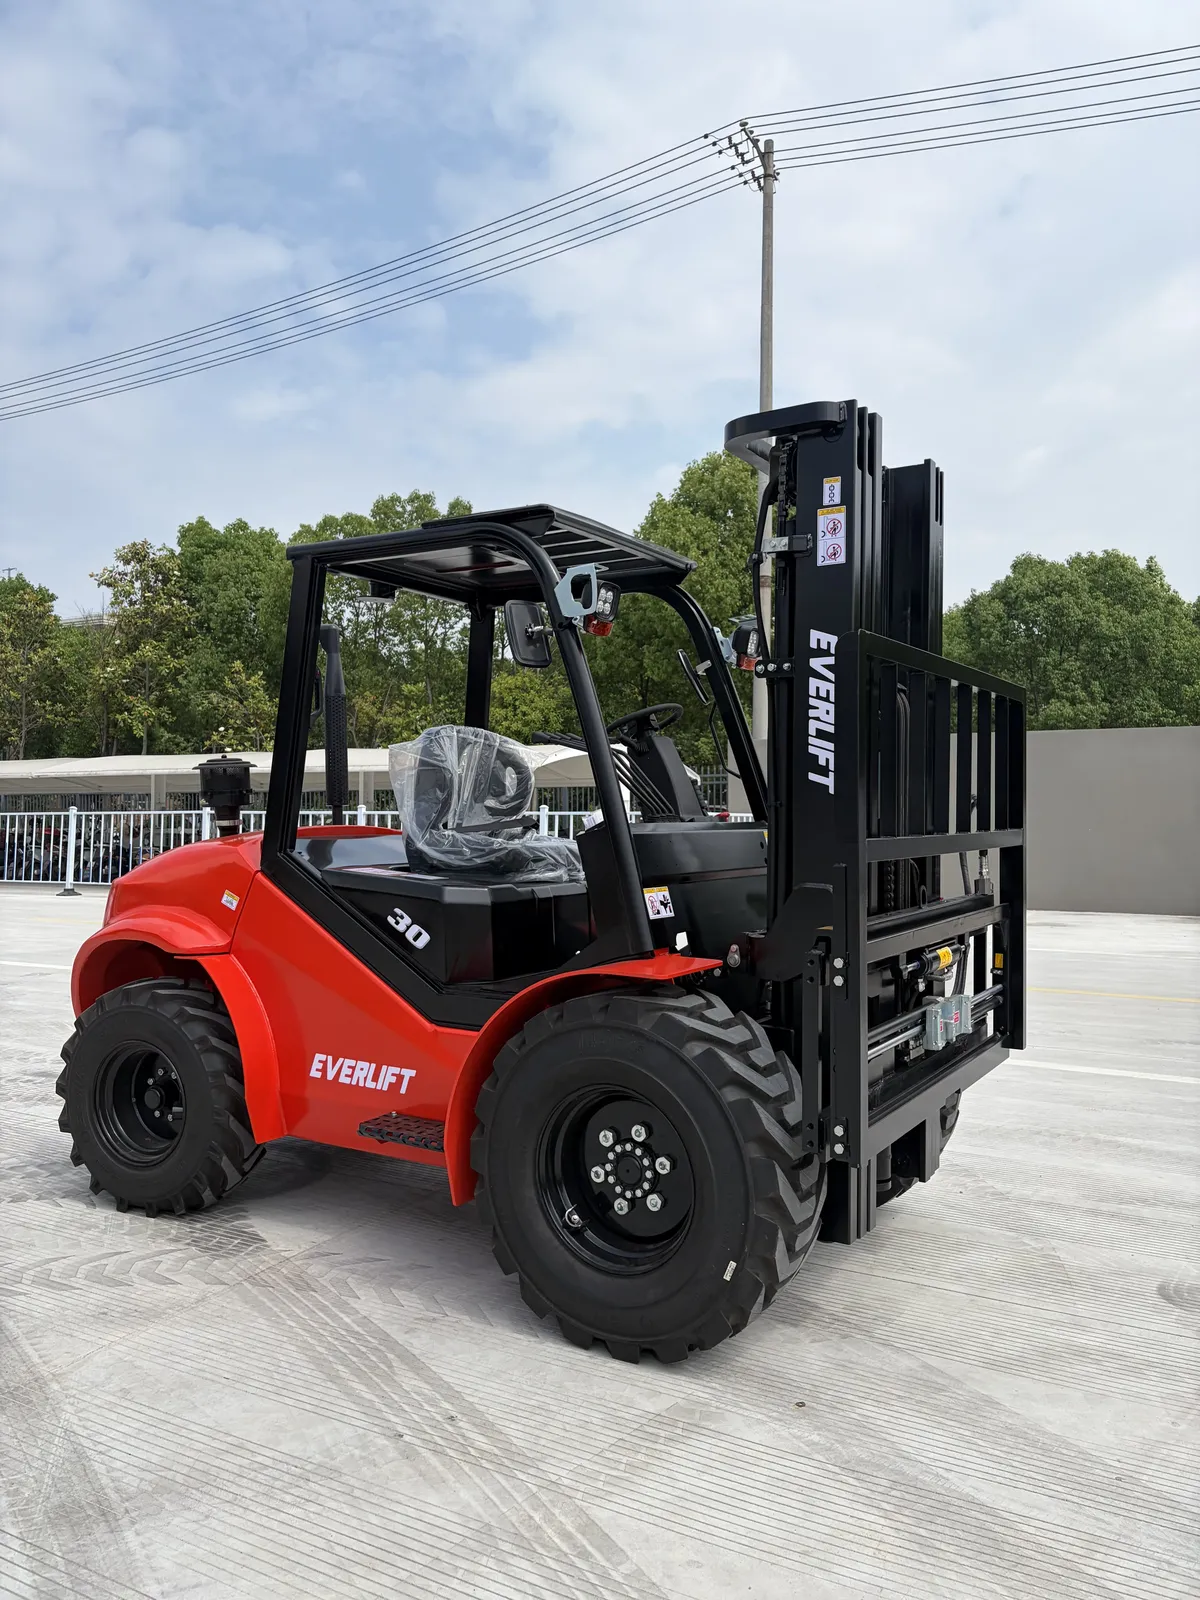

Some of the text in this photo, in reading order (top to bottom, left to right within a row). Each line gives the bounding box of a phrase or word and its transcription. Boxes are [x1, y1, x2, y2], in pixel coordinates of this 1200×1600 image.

[808, 628, 838, 795] EVERLIFT
[387, 907, 431, 950] 30
[309, 1053, 417, 1094] EVERLIFT
